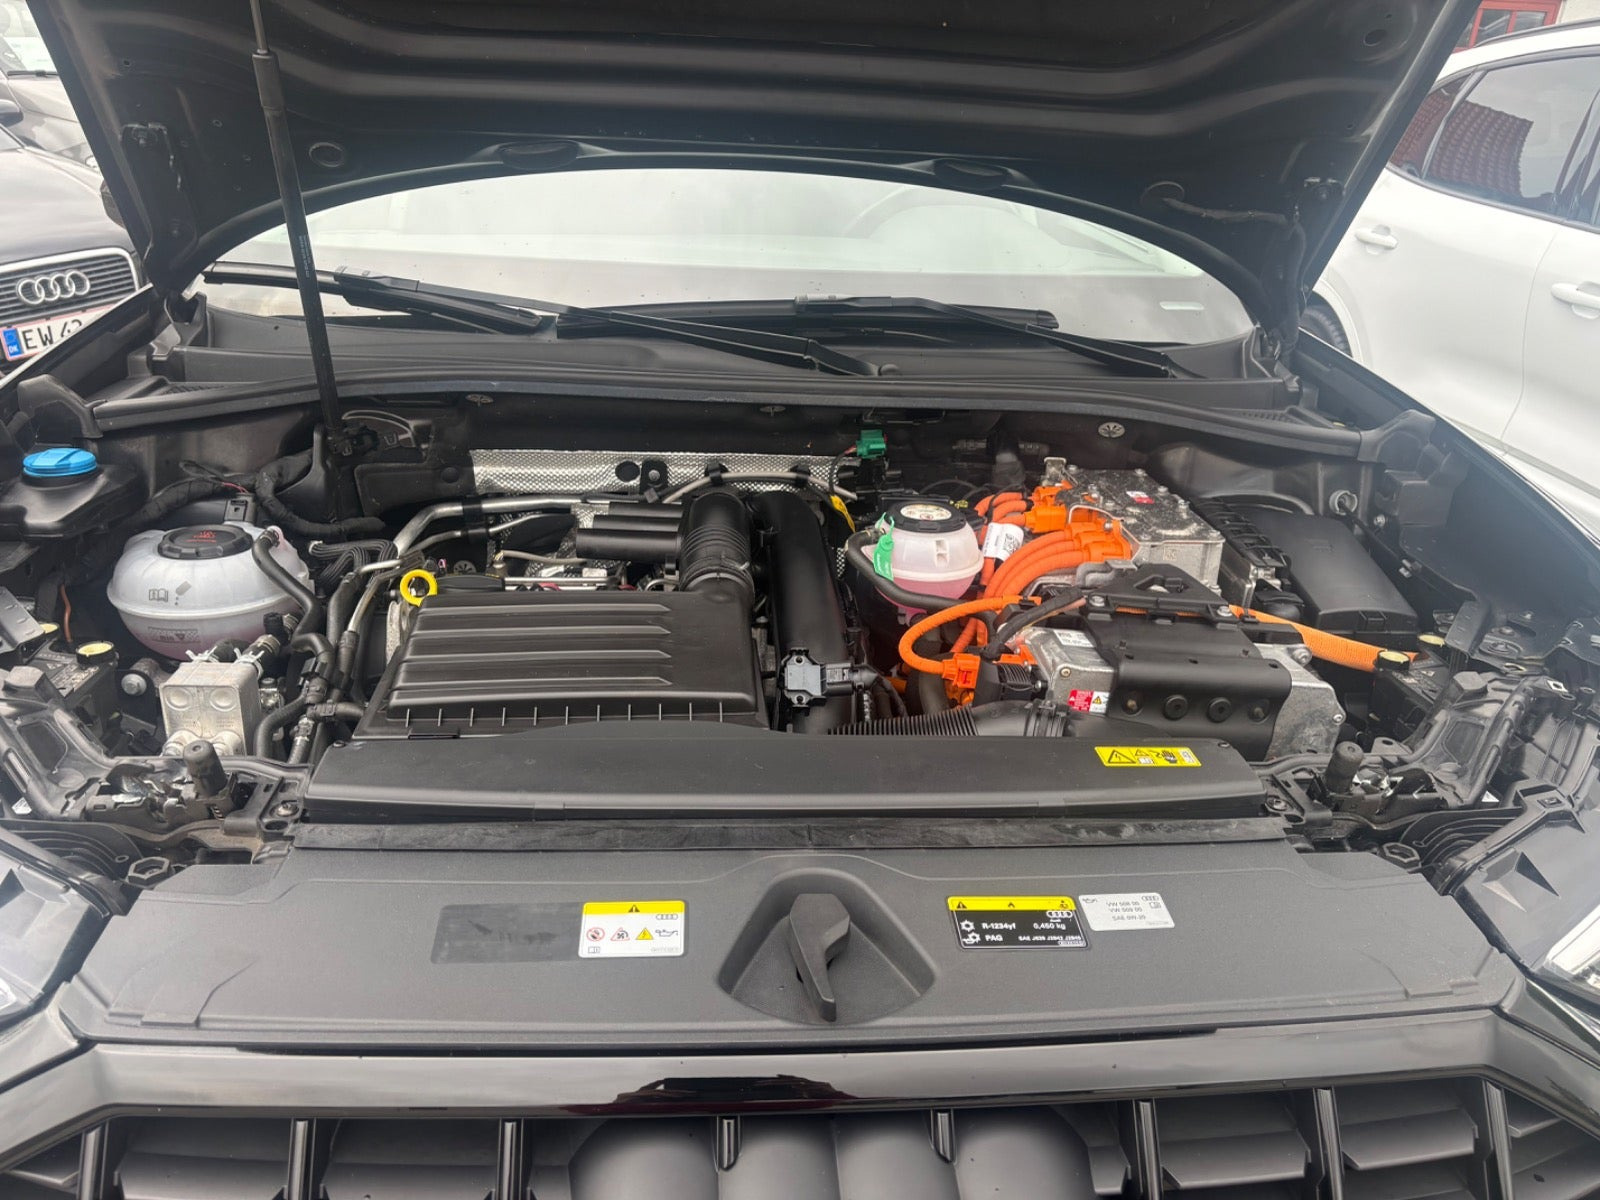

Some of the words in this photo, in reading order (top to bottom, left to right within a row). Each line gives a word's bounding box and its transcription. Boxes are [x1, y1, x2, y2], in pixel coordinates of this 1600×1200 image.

[22, 325, 54, 349] EW
[8, 344, 19, 353] DK
[981, 922, 1016, 931] R-1234yf
[984, 934, 1003, 942] PAG
